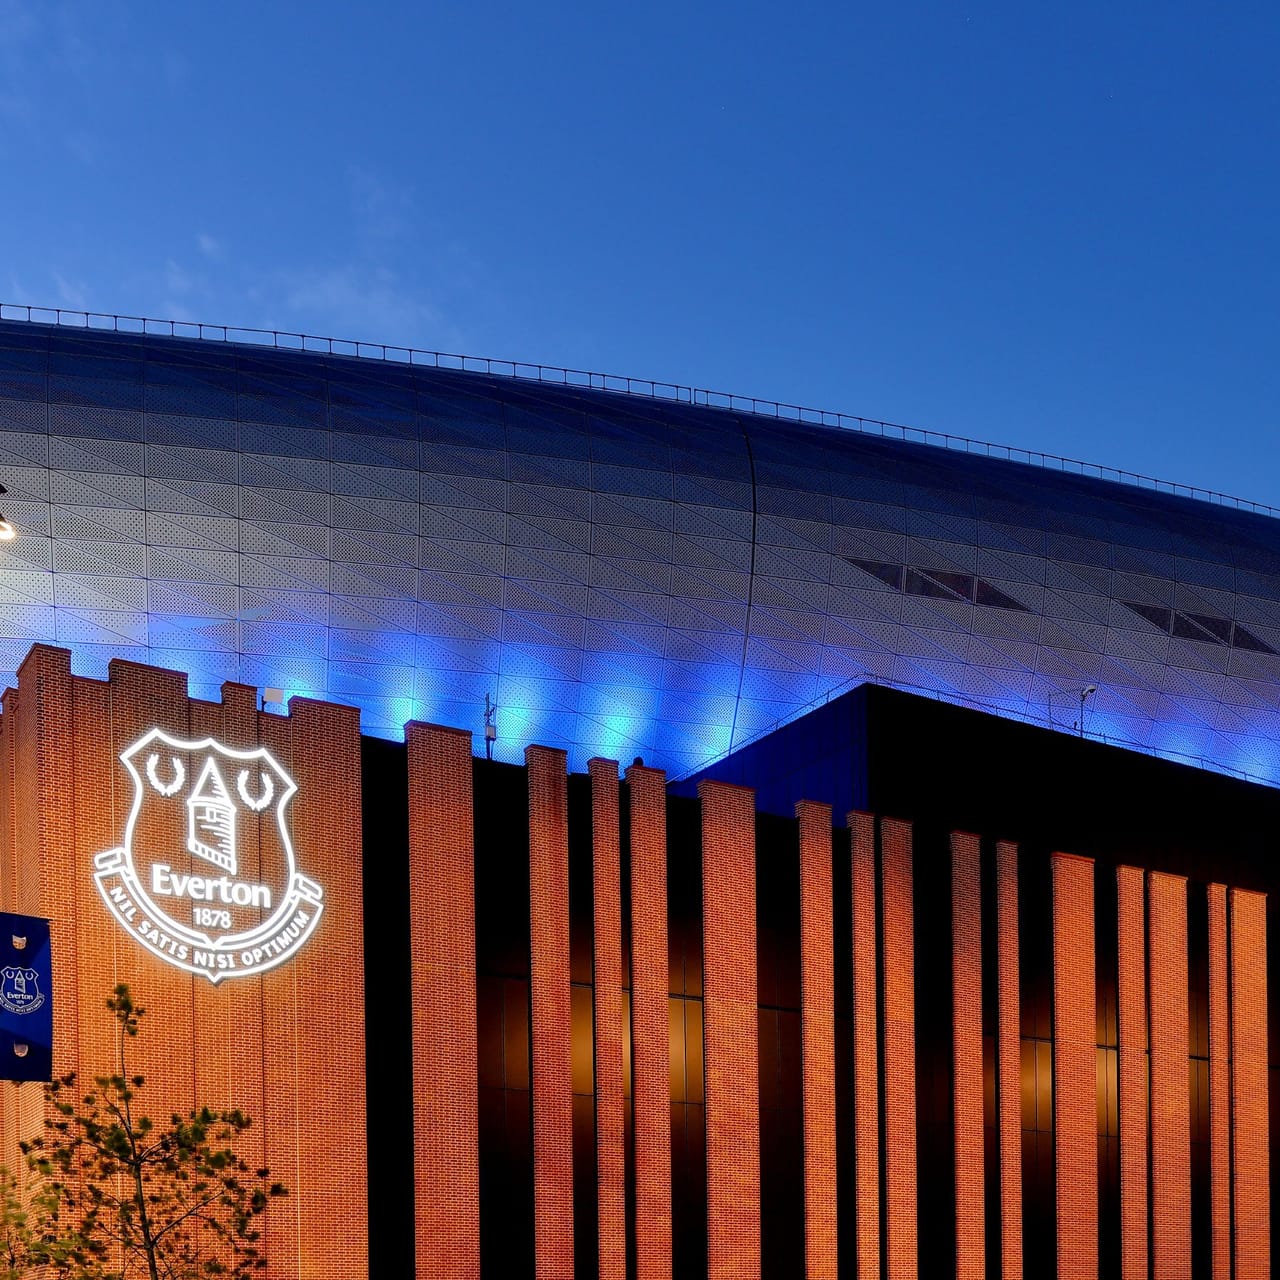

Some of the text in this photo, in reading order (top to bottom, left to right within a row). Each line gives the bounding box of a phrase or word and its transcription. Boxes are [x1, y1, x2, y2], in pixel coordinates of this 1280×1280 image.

[152, 863, 272, 908] Everton
[110, 886, 310, 969] NIL SATIS NISI OPTIMUM
[193, 907, 232, 929] 1878
[7, 992, 34, 1000] Everton
